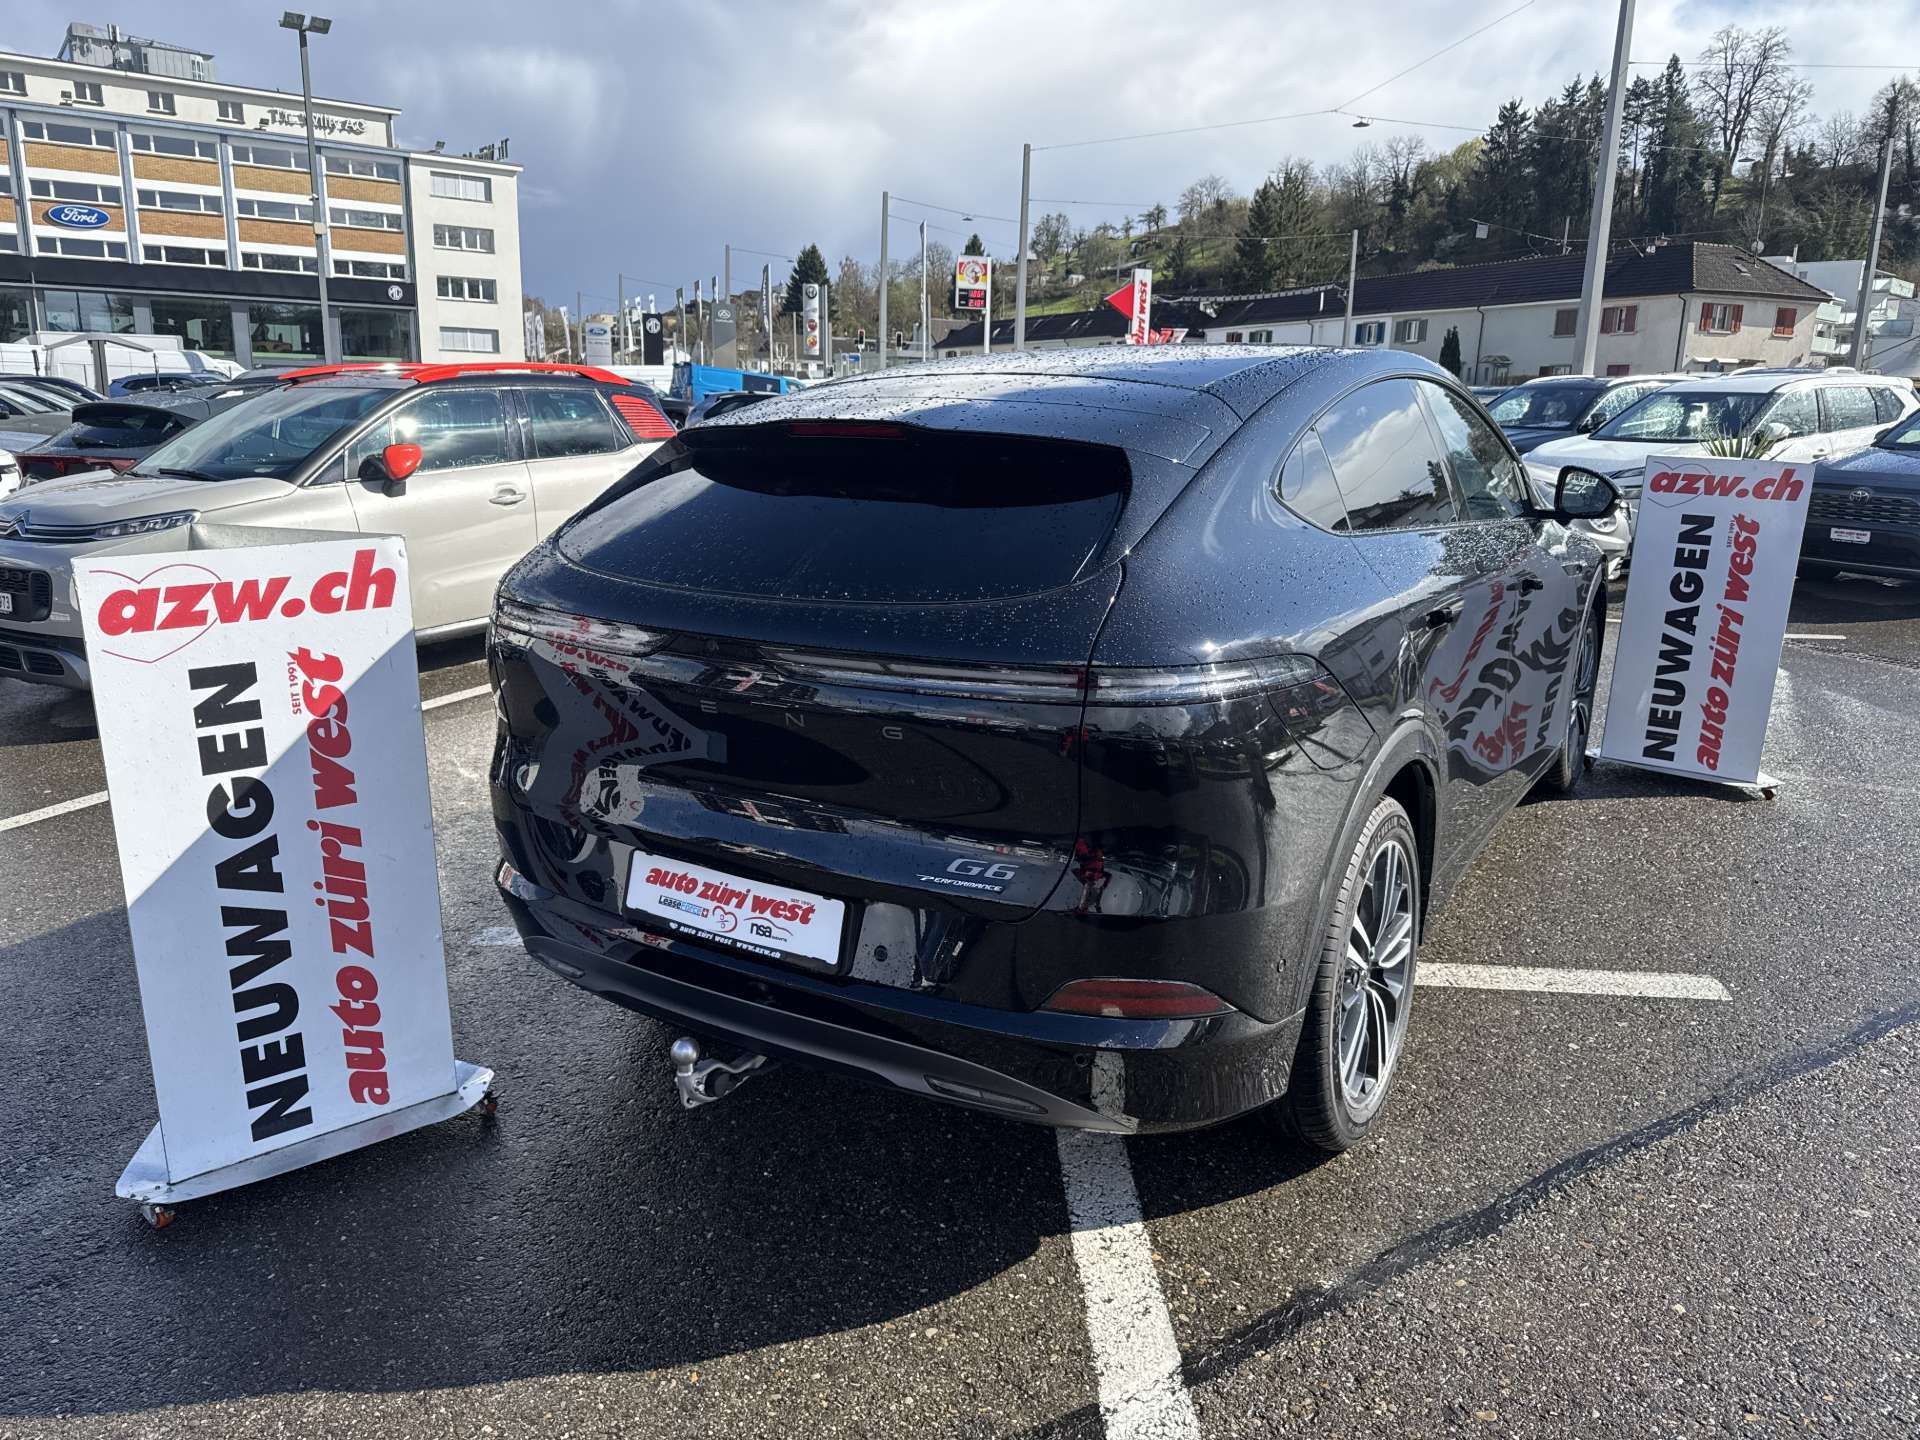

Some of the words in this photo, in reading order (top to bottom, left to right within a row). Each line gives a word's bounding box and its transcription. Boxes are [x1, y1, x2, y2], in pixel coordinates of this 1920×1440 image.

[61, 207, 98, 223] Ford
[1650, 468, 1804, 501] azw.ch
[98, 550, 396, 636] azw.ch
[1724, 513, 1761, 602] west
[1643, 514, 1715, 762] NEUWAGEN
[1709, 603, 1745, 688] züri
[286, 646, 358, 812] west
[291, 692, 302, 715] SEIT
[1696, 686, 1729, 771] auto
[188, 660, 314, 1143] NEUWAGEN
[307, 820, 374, 959] züri
[645, 867, 698, 894] auto
[697, 881, 751, 910] züri
[751, 894, 816, 925] west
[916, 873, 1003, 892] PERFORMANCE
[946, 858, 1020, 880] G6
[750, 922, 772, 939] nsa
[328, 966, 390, 1106] auto
